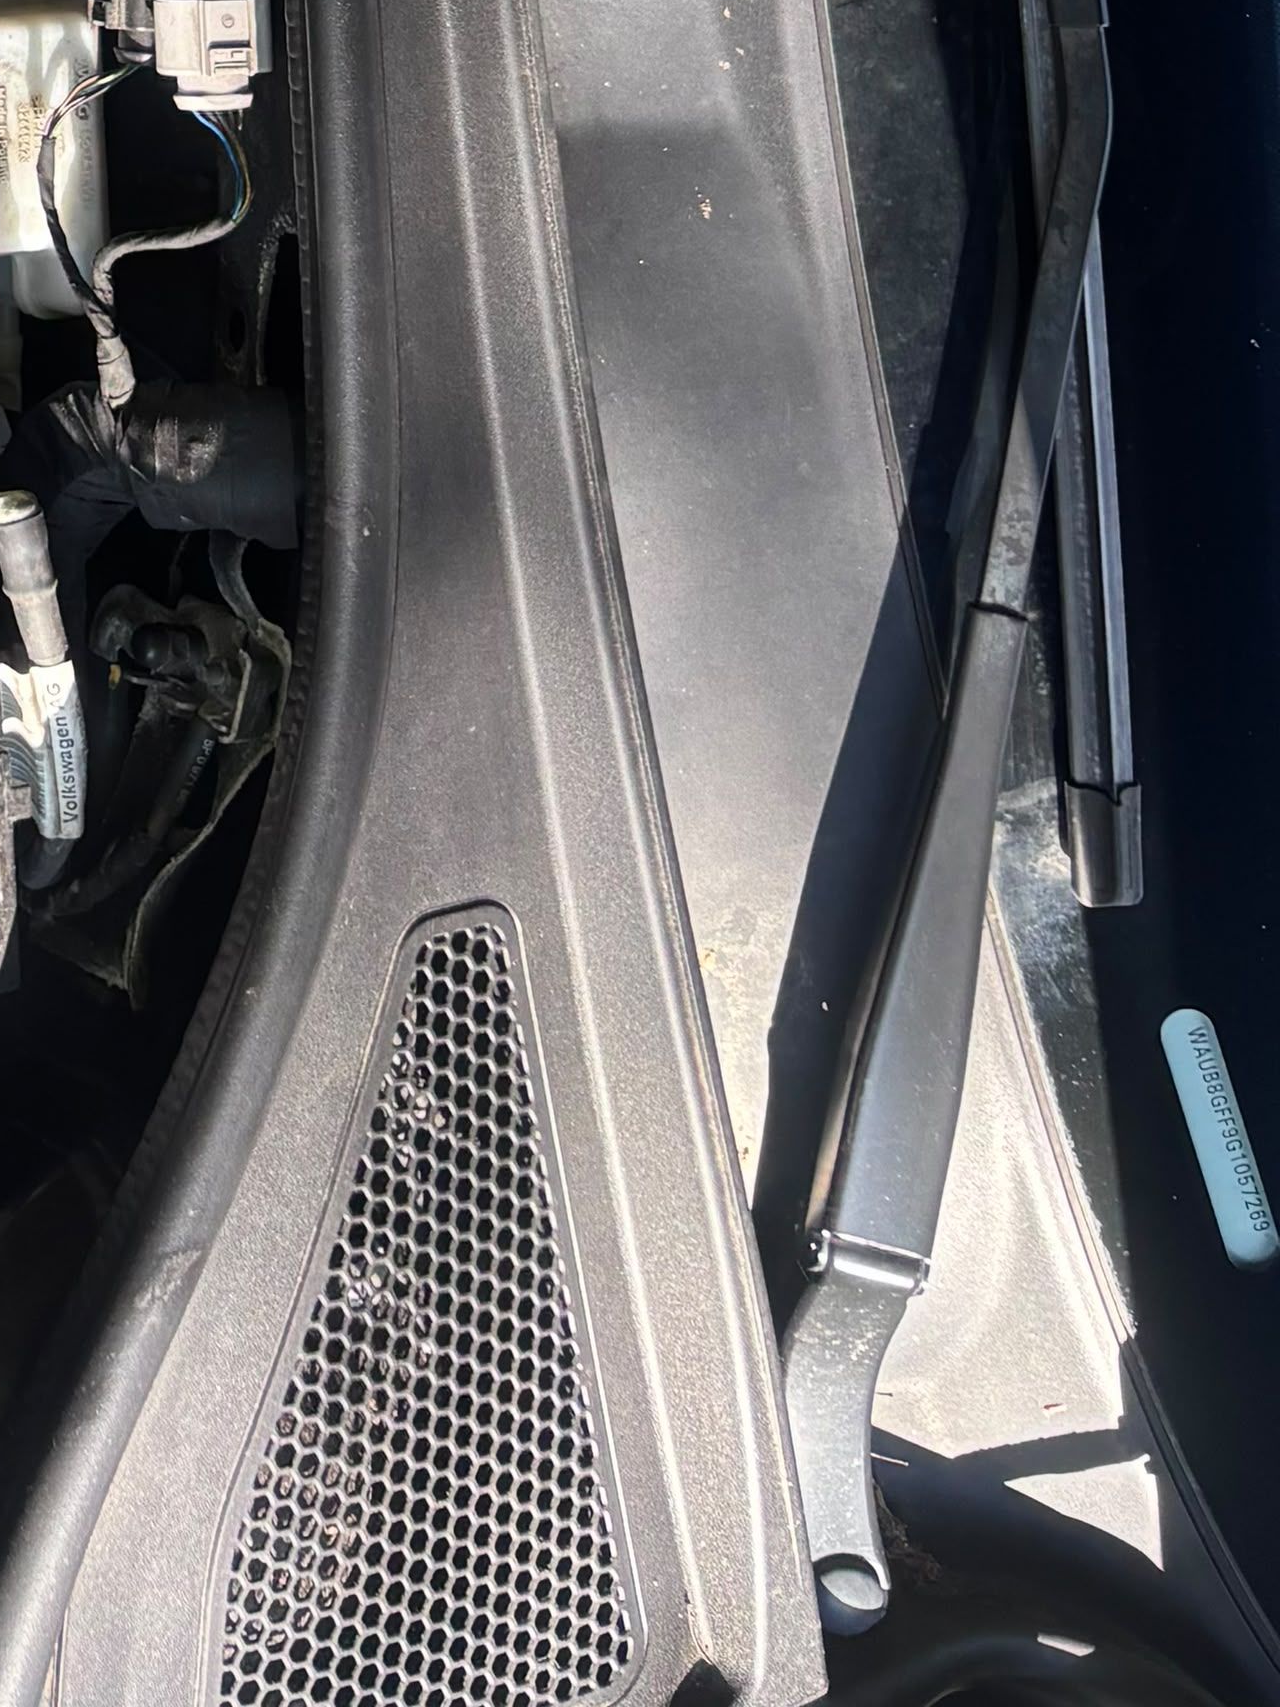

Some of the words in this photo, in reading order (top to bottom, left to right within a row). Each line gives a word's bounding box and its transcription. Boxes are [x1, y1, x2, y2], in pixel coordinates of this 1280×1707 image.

[47, 681, 64, 711] AG
[52, 715, 77, 824] Volkswagen
[1186, 1025, 1271, 1233] WAUB8GFF9G1057269
